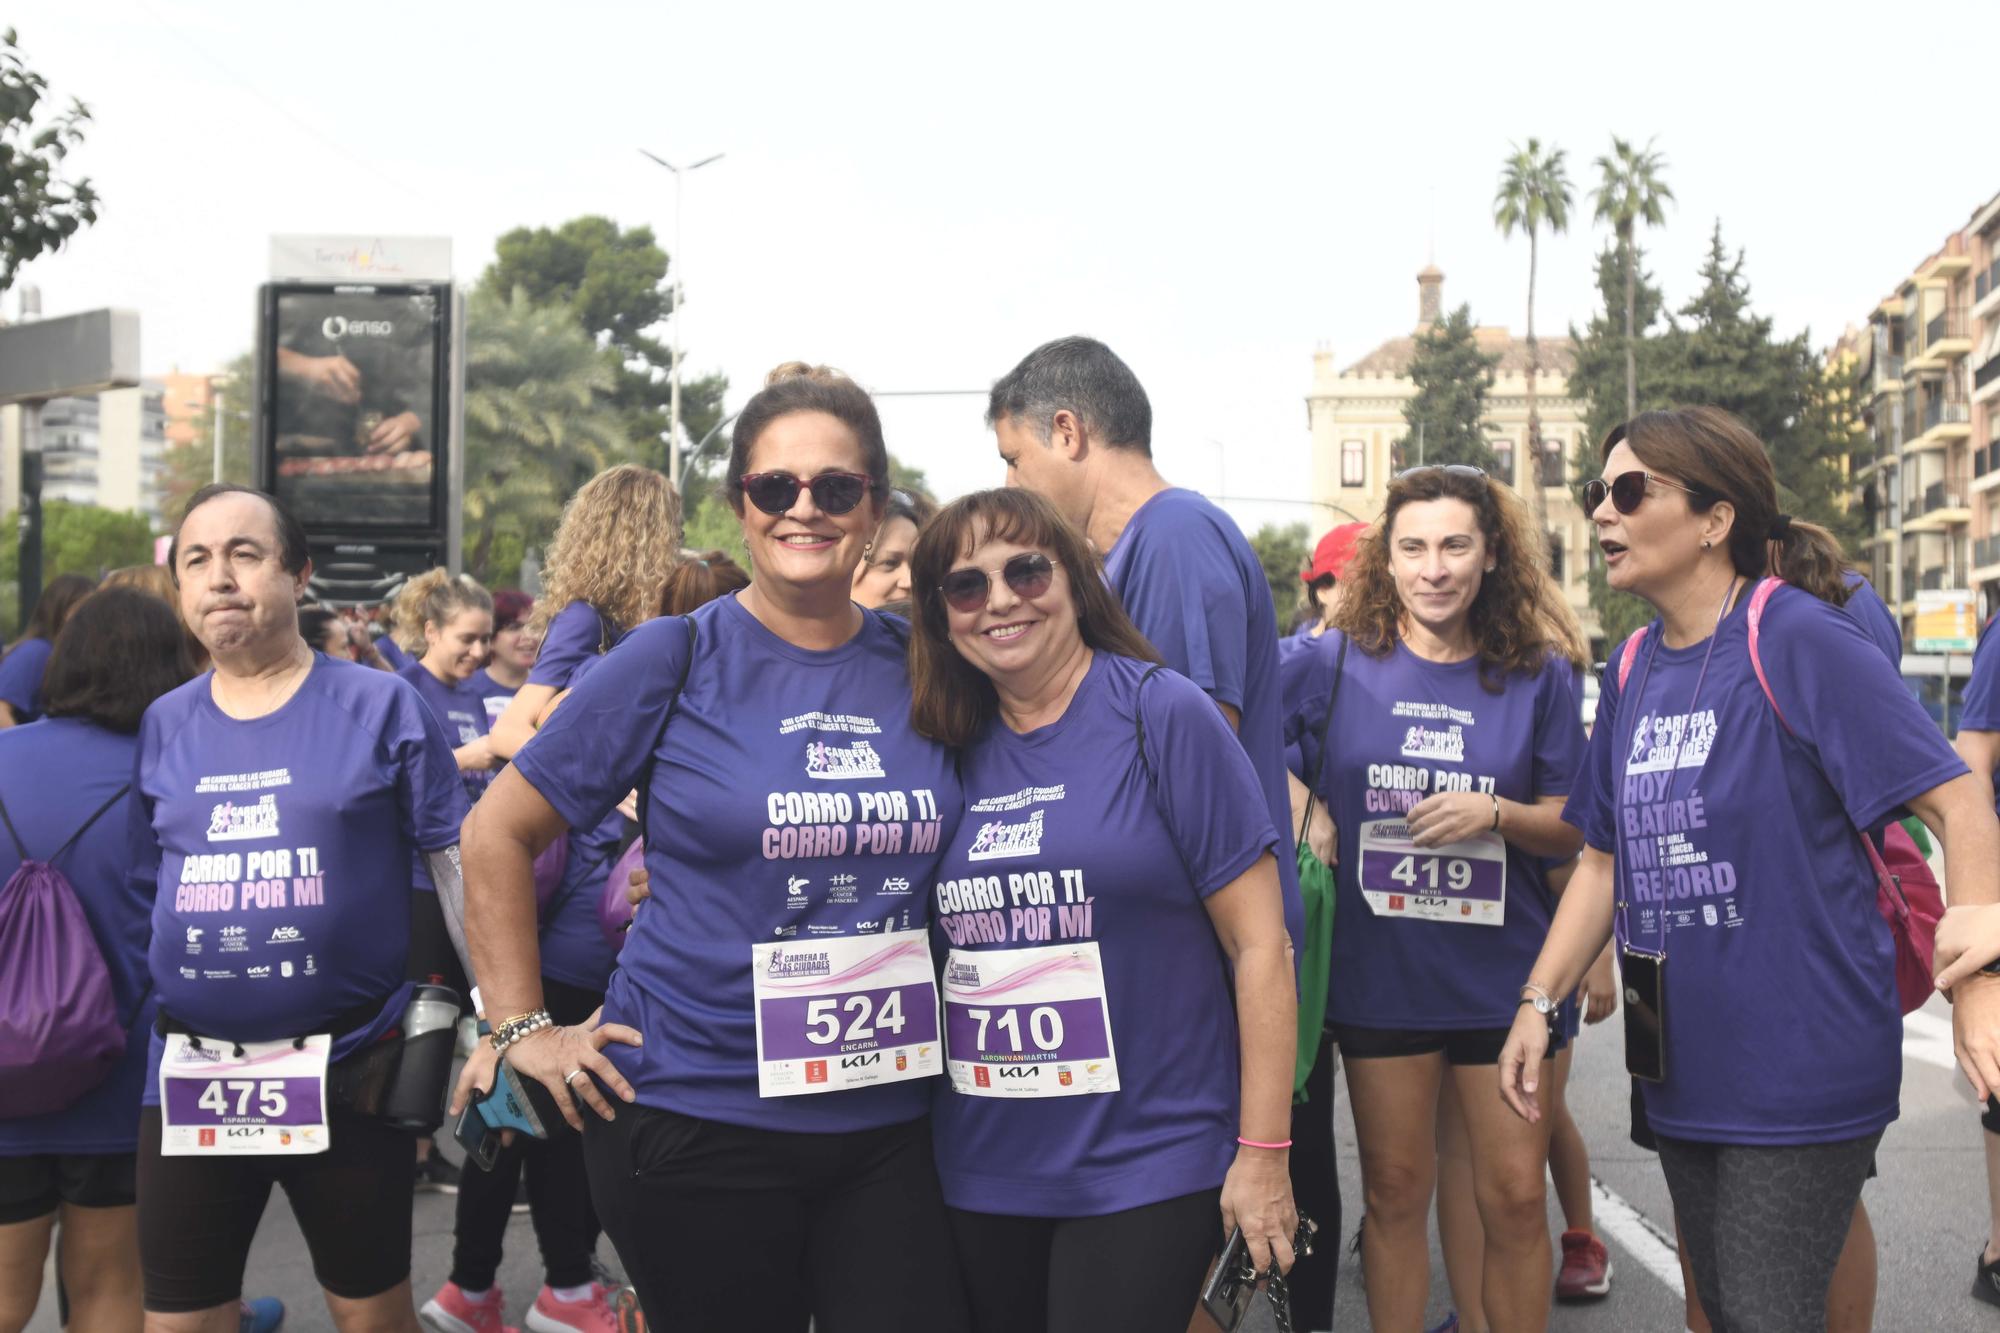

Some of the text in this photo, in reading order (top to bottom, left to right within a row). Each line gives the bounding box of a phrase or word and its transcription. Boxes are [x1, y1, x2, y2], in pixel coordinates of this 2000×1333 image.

[348, 320, 392, 335] enso
[832, 715, 845, 723] LAS
[824, 747, 875, 760] CARRERA
[1368, 763, 1496, 795] CORRO POR TI
[1623, 771, 1671, 806] HOY
[768, 788, 937, 826] CORRO POR TI
[1623, 789, 1708, 838] BATIRÉ
[762, 815, 943, 860] CORRO POR MÍ
[1628, 838, 1658, 871] MI
[181, 847, 318, 884] CORRO POR TI
[1391, 855, 1472, 890] 419
[1632, 861, 1737, 903] RECORD
[175, 870, 326, 913] CORRO POR MÍ
[882, 877, 910, 891] AEG
[936, 868, 1085, 915] CORRO POR TI
[271, 926, 299, 940] AEG
[939, 896, 1096, 947] CORRO POR MÍ
[793, 960, 830, 971] CIUDADES
[819, 952, 829, 960] DE
[806, 990, 905, 1045] 524
[968, 1006, 1064, 1052] 710
[840, 1040, 879, 1052] ENCARNA
[841, 1052, 881, 1069] KIA
[980, 1053, 1058, 1062] AARONIVANMARTIN
[1000, 1066, 1040, 1078] KIA
[198, 1080, 288, 1117] 475
